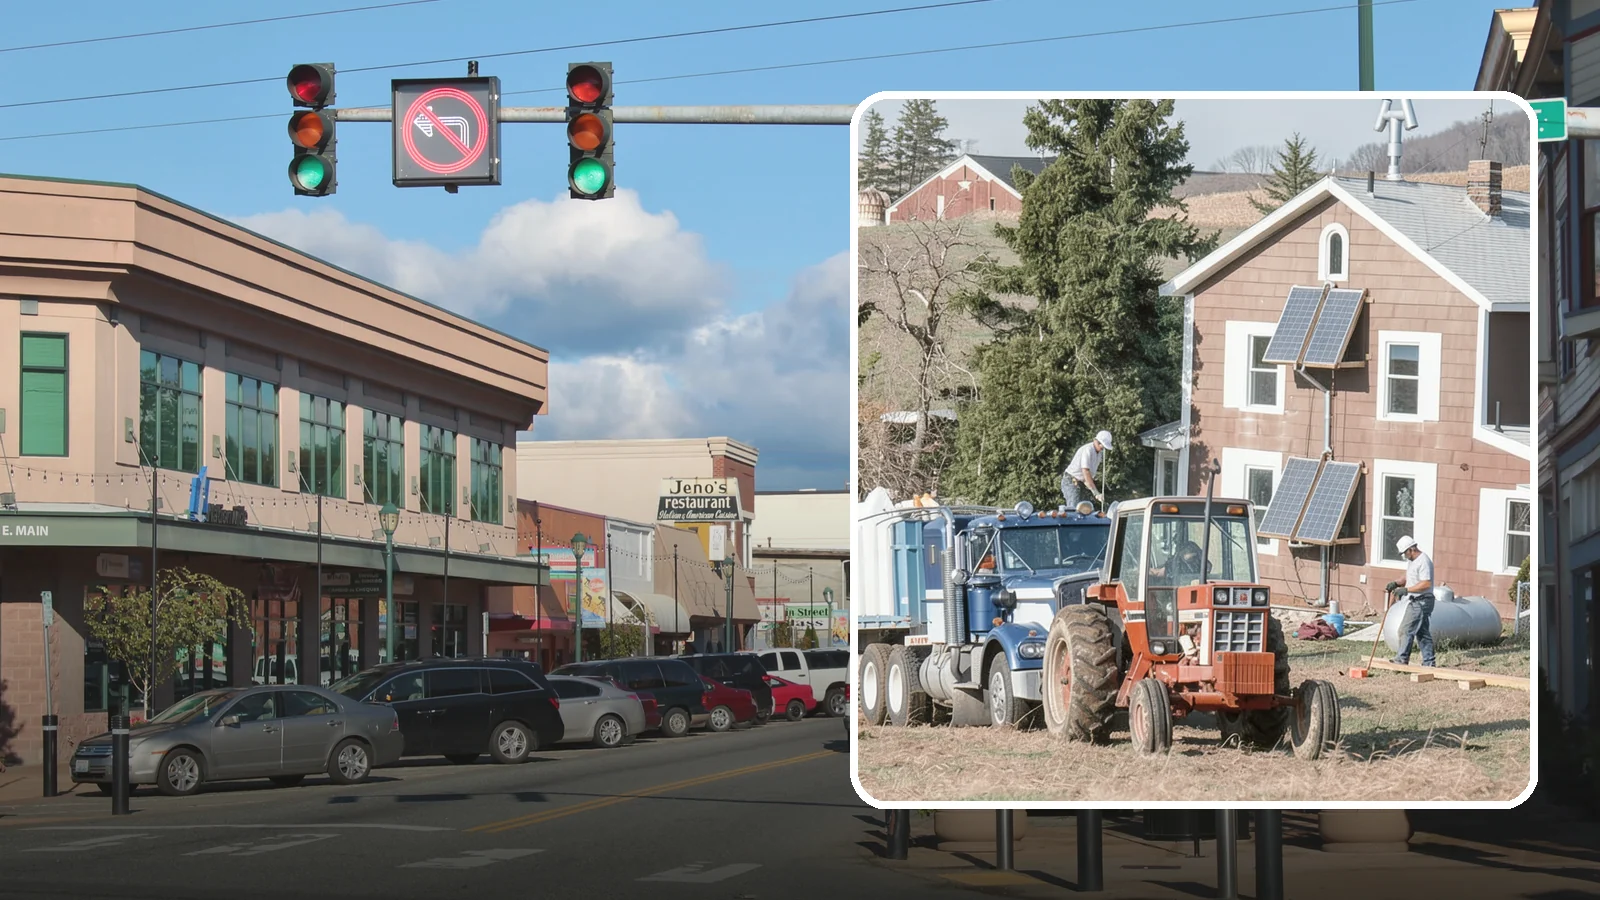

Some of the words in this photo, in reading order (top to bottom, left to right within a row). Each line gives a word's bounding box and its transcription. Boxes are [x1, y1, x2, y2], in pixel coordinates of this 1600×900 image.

[670, 480, 727, 494] Jeno's
[665, 497, 731, 509] restaurant
[659, 510, 681, 519] Italian
[686, 510, 714, 519] American
[715, 510, 737, 519] Cuisine
[2, 525, 13, 536] E.
[15, 525, 49, 536] MAIN
[786, 608, 794, 616] in
[798, 608, 828, 617] Street
